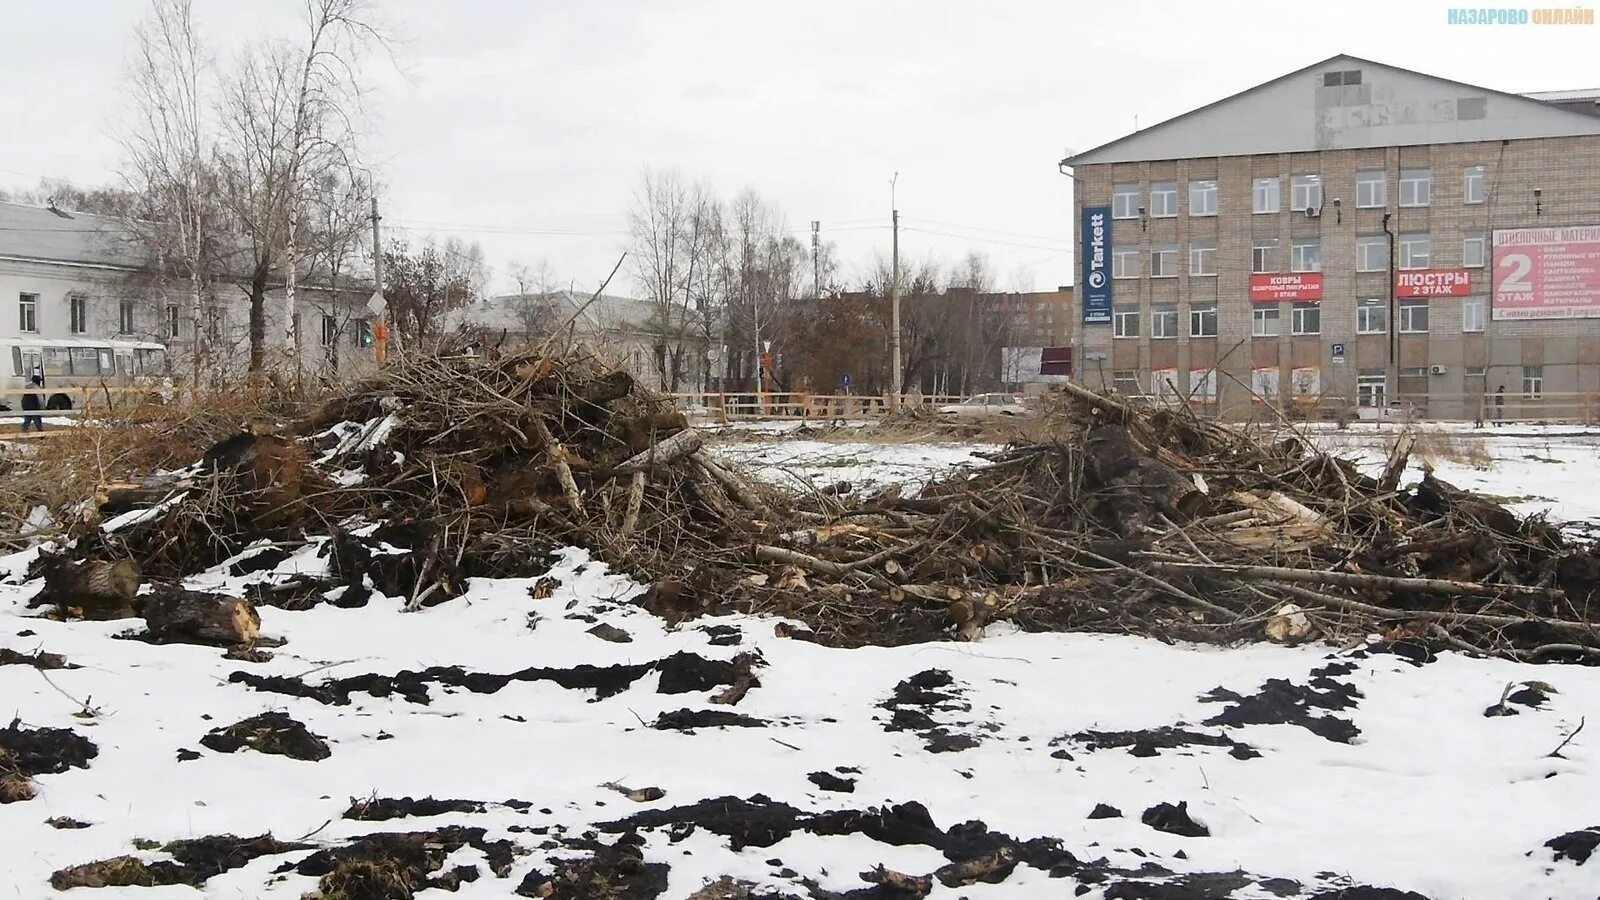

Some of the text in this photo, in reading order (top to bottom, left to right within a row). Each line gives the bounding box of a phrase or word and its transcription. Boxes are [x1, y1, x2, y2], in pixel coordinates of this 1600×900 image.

[1090, 213, 1104, 271] Tarkett
[1498, 253, 1532, 292] 2
[1270, 276, 1301, 285] КОВРЫ
[1397, 272, 1469, 287] ЛЮСТРЫ
[1412, 285, 1452, 295] 2 ЭТАЖ
[1497, 292, 1535, 302] ЭТАЖ
